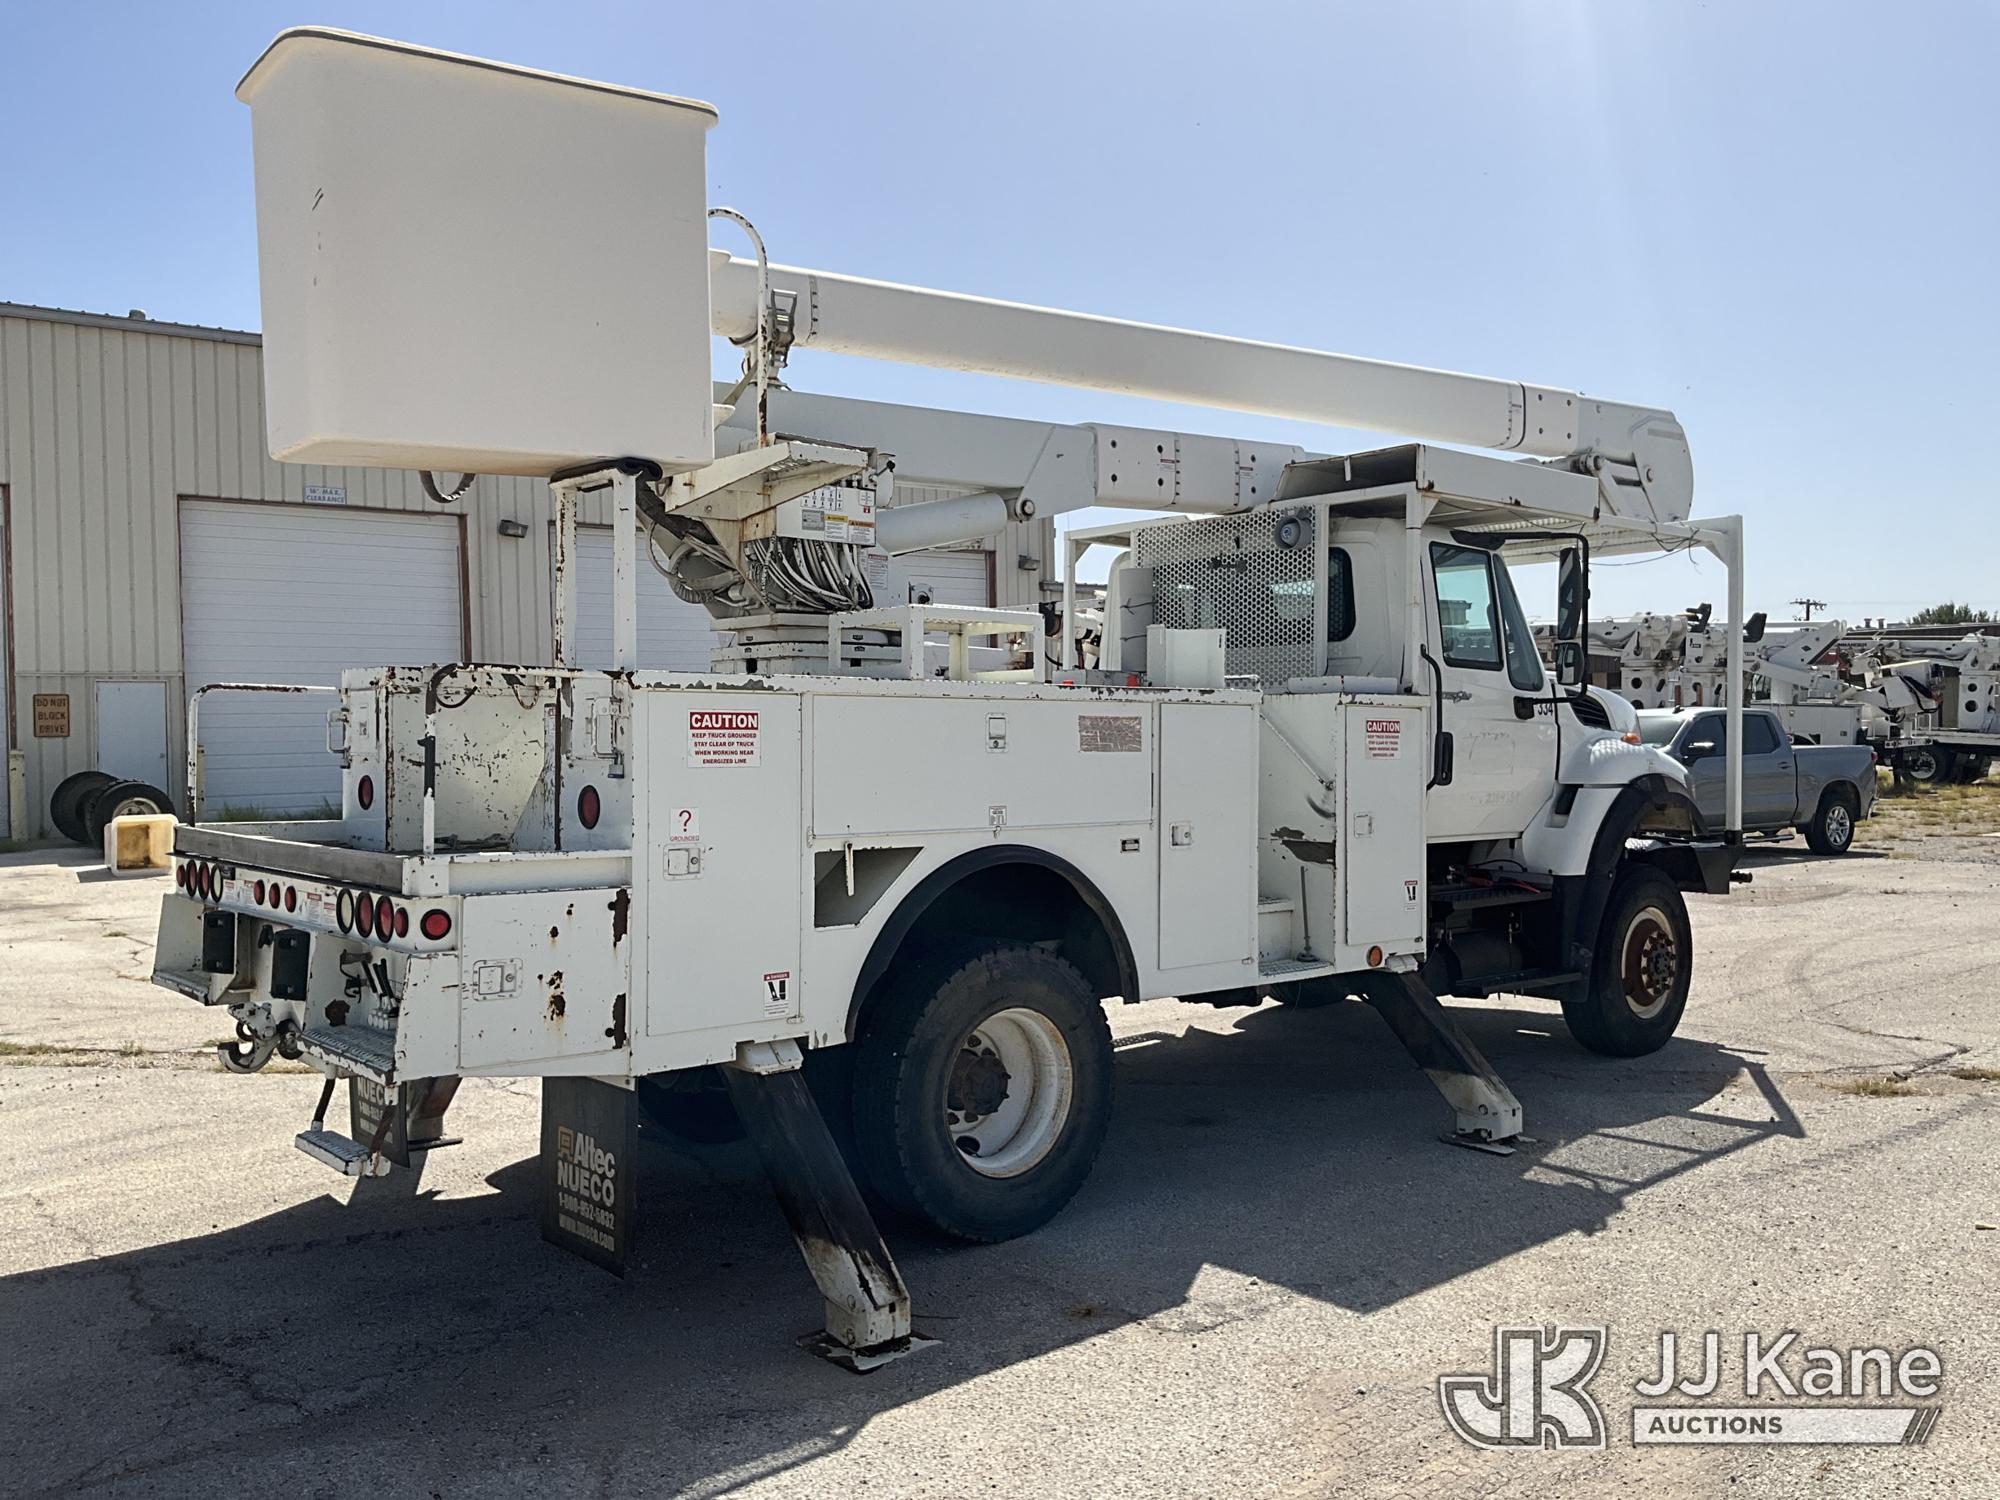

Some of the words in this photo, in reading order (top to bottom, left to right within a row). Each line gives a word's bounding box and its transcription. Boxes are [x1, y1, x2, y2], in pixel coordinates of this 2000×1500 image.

[36, 698, 48, 707] DO
[50, 698, 66, 707] NOT
[38, 711, 66, 720] BLOCK
[691, 714, 758, 728] CAUTION
[39, 725, 65, 734] DRIVE
[1367, 721, 1400, 732] CAUTION
[679, 810, 692, 832] ?
[357, 1076, 385, 1106] NUEC
[573, 1132, 616, 1179] Altec
[557, 1159, 615, 1207] NUECO
